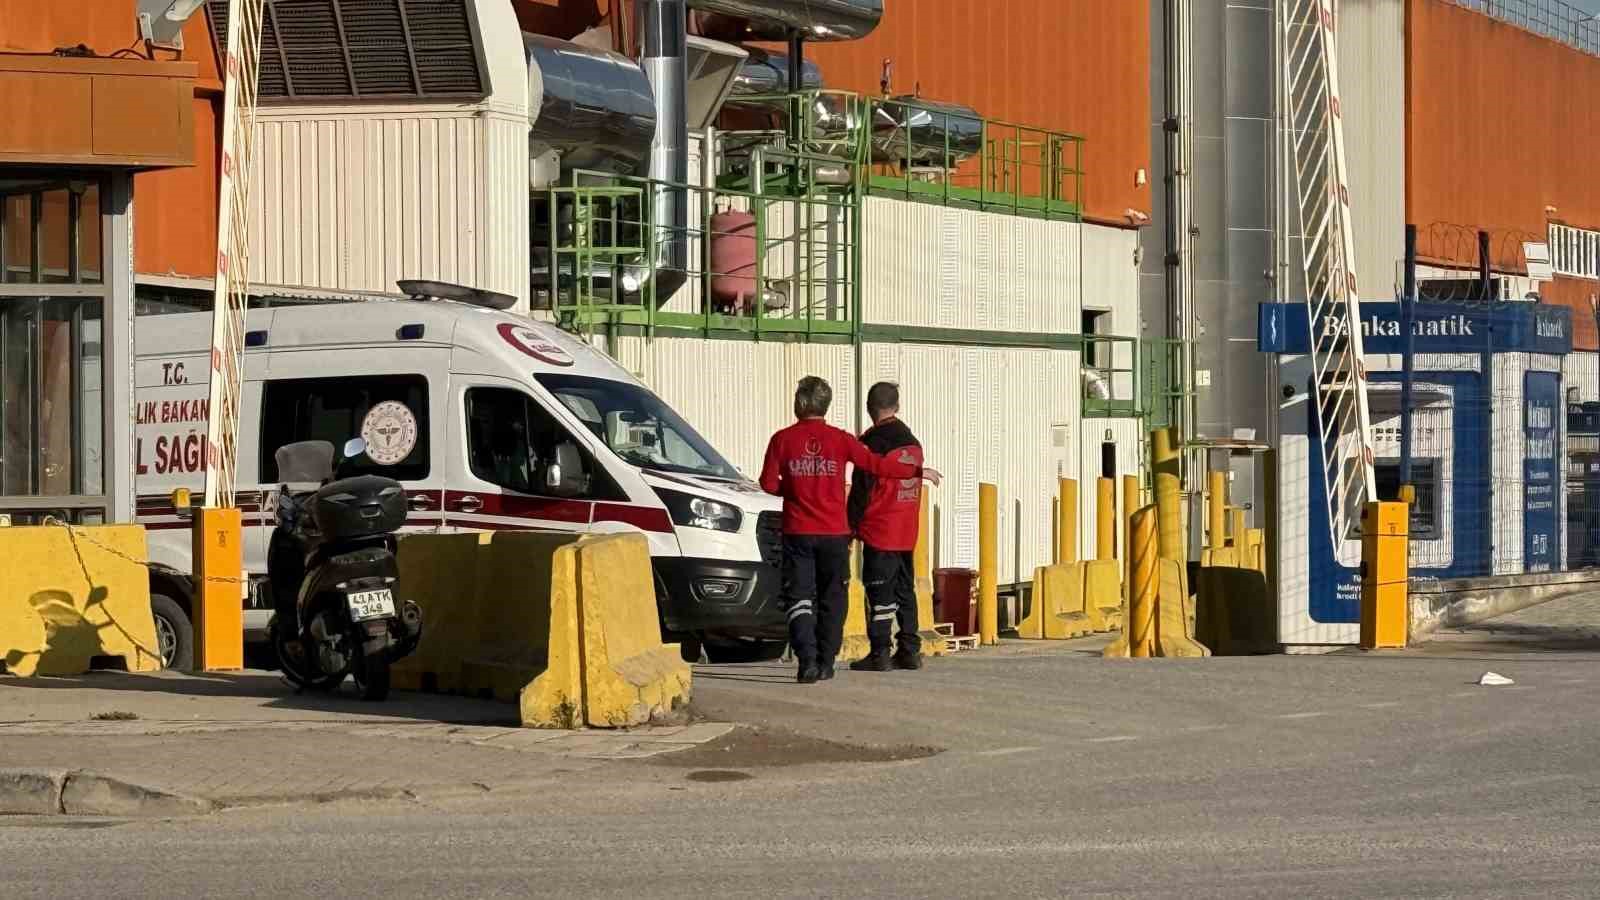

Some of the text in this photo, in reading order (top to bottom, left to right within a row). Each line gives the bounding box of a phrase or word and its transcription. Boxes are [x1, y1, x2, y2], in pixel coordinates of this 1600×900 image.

[163, 362, 188, 385] T.C.
[136, 399, 210, 424] LIK BAKAN
[155, 429, 208, 474] SAĞL
